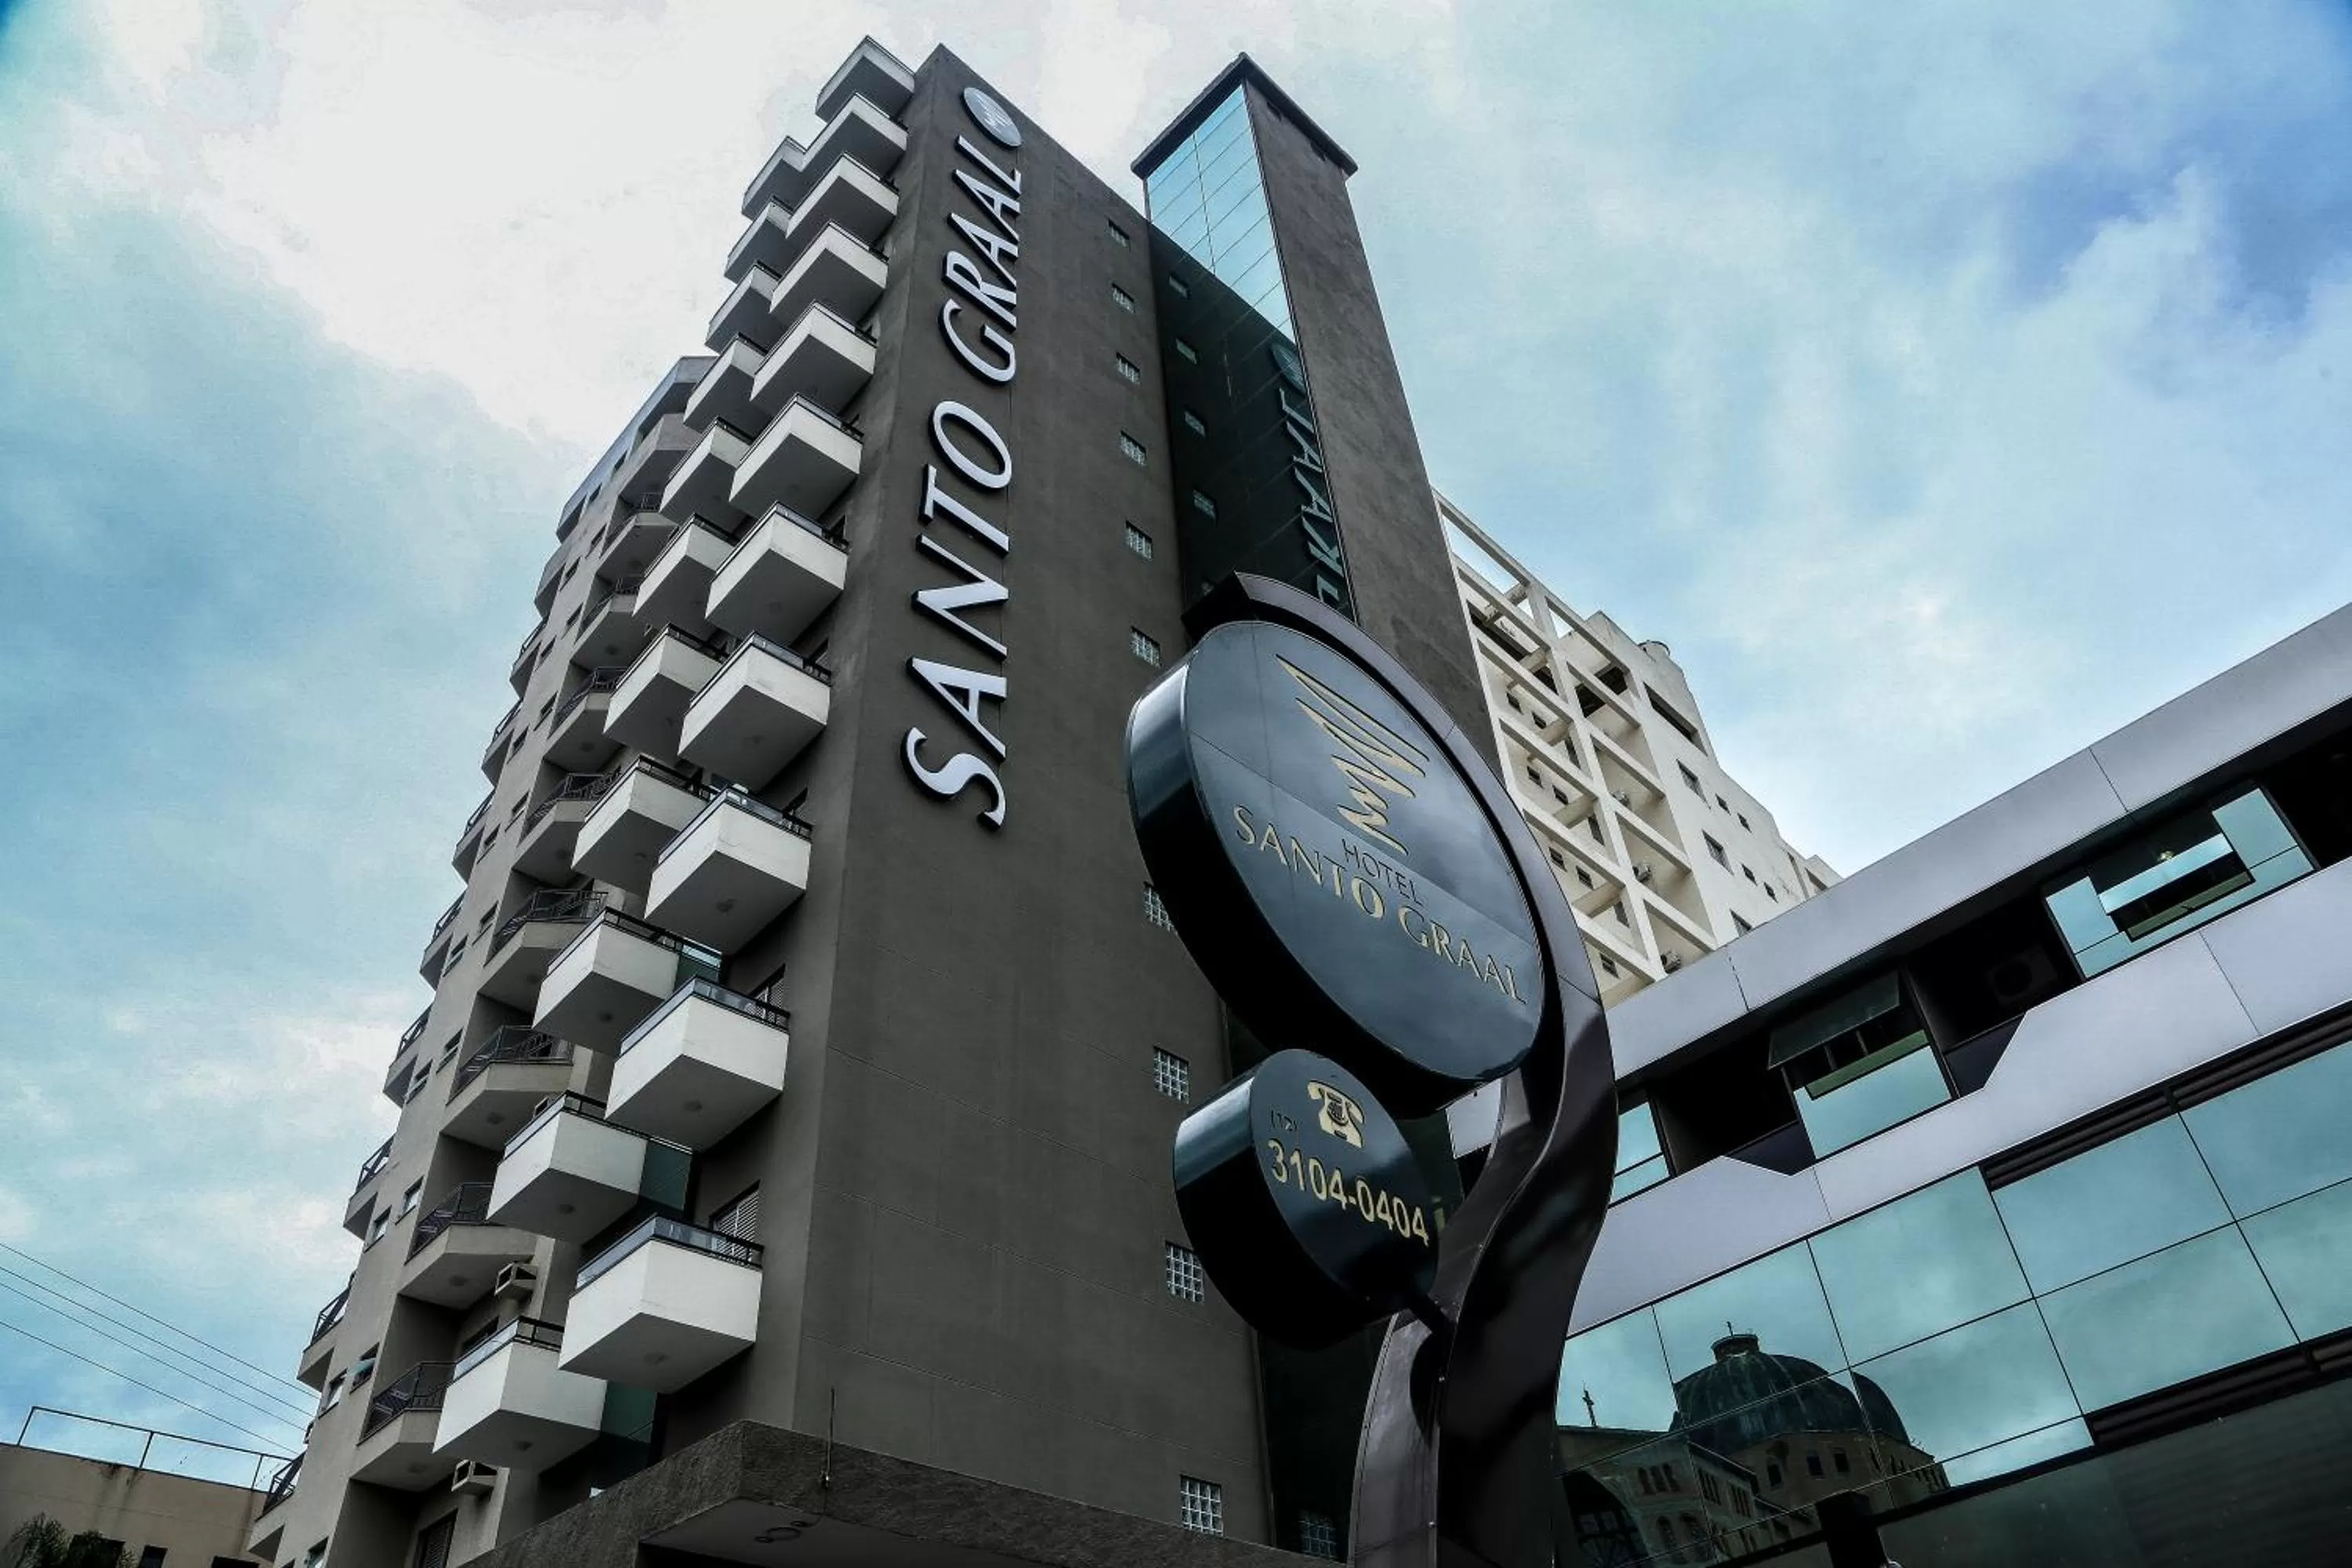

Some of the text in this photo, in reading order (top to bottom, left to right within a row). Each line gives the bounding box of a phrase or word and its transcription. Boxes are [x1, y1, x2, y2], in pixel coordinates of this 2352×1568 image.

[900, 135, 1022, 830] SANTO GRAAL
[1233, 804, 1528, 1005] SANTO GRAAL
[1341, 838, 1426, 907] HOTEL
[1268, 1138, 1430, 1247] 3104-0404
